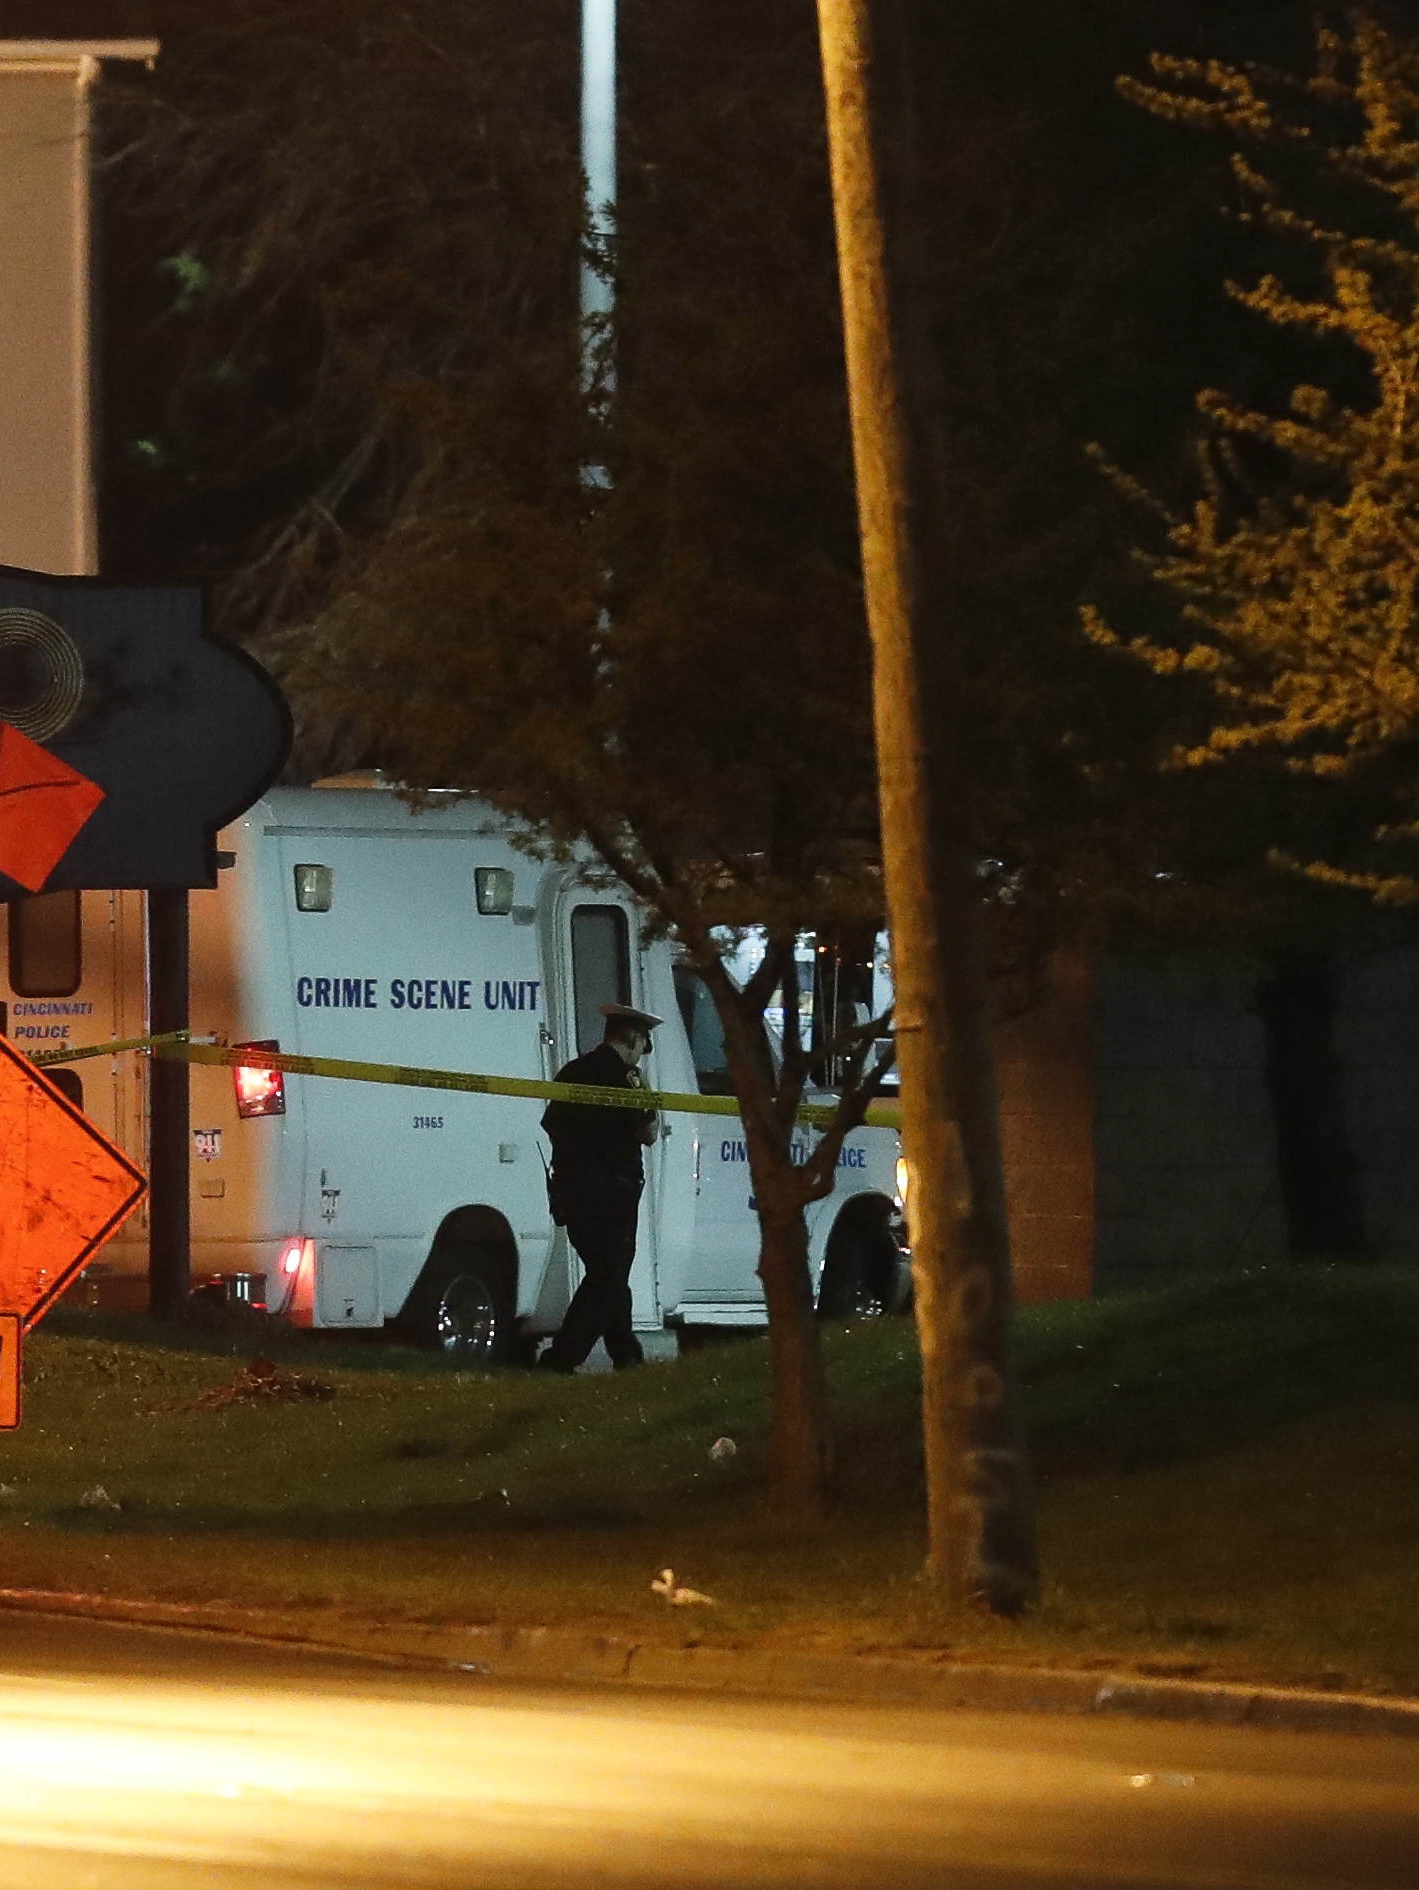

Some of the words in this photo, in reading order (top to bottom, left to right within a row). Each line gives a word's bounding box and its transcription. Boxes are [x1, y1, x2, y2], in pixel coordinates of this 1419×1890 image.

[297, 976, 378, 1008] CRIME
[390, 979, 471, 1009] SCENE
[485, 980, 540, 1010] UNIT
[13, 1002, 93, 1016] CINCINNATI
[15, 1025, 70, 1039] POLICE
